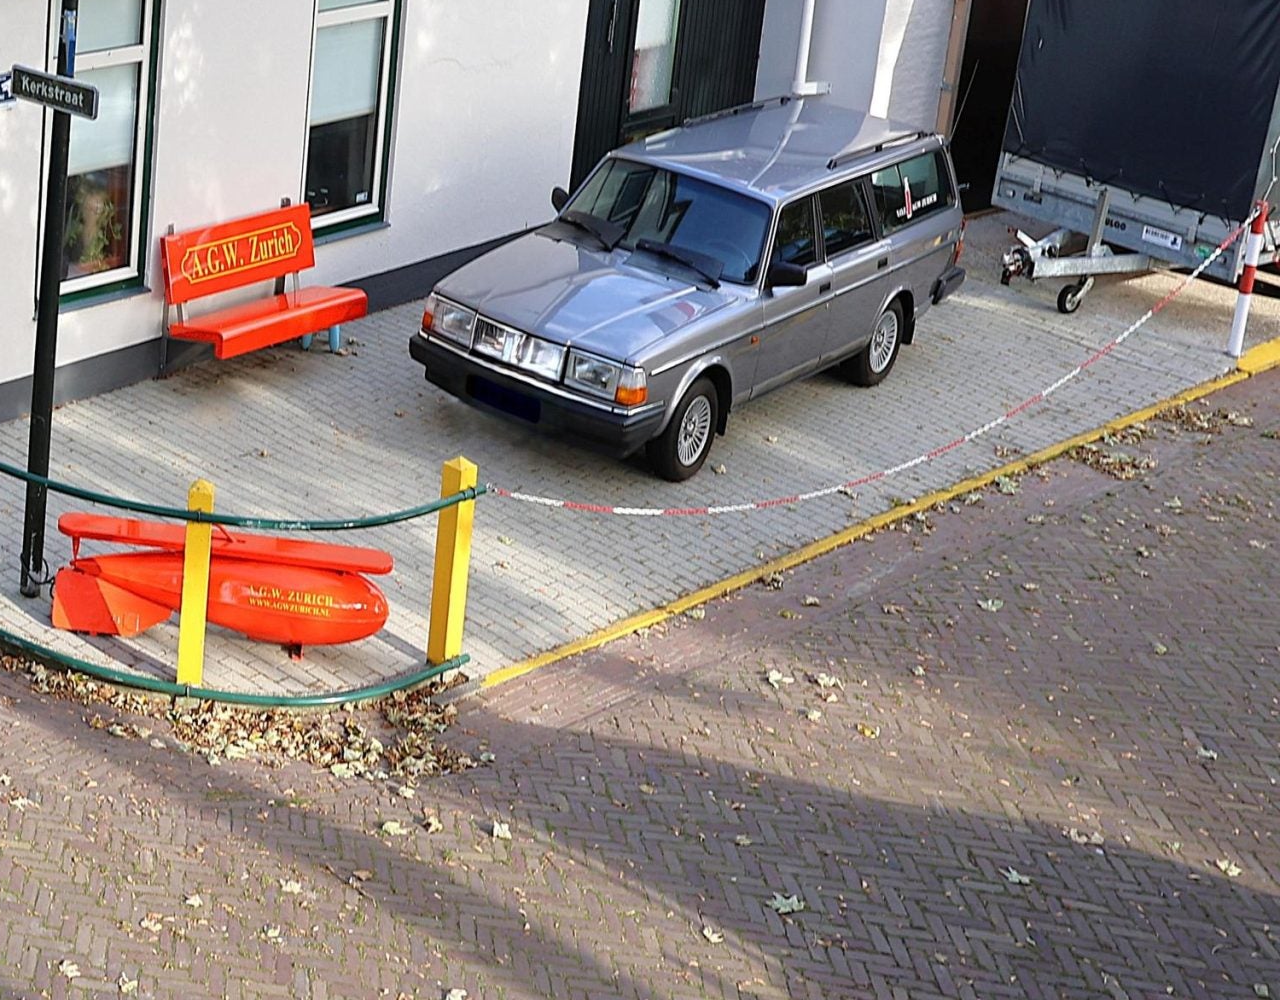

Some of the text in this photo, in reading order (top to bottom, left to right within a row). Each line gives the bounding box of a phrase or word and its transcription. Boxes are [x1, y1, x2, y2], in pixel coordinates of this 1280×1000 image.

[21, 75, 84, 107] Kerkstraat
[192, 228, 294, 279] A.G.W. Zurich
[288, 591, 333, 608] ZURICH
